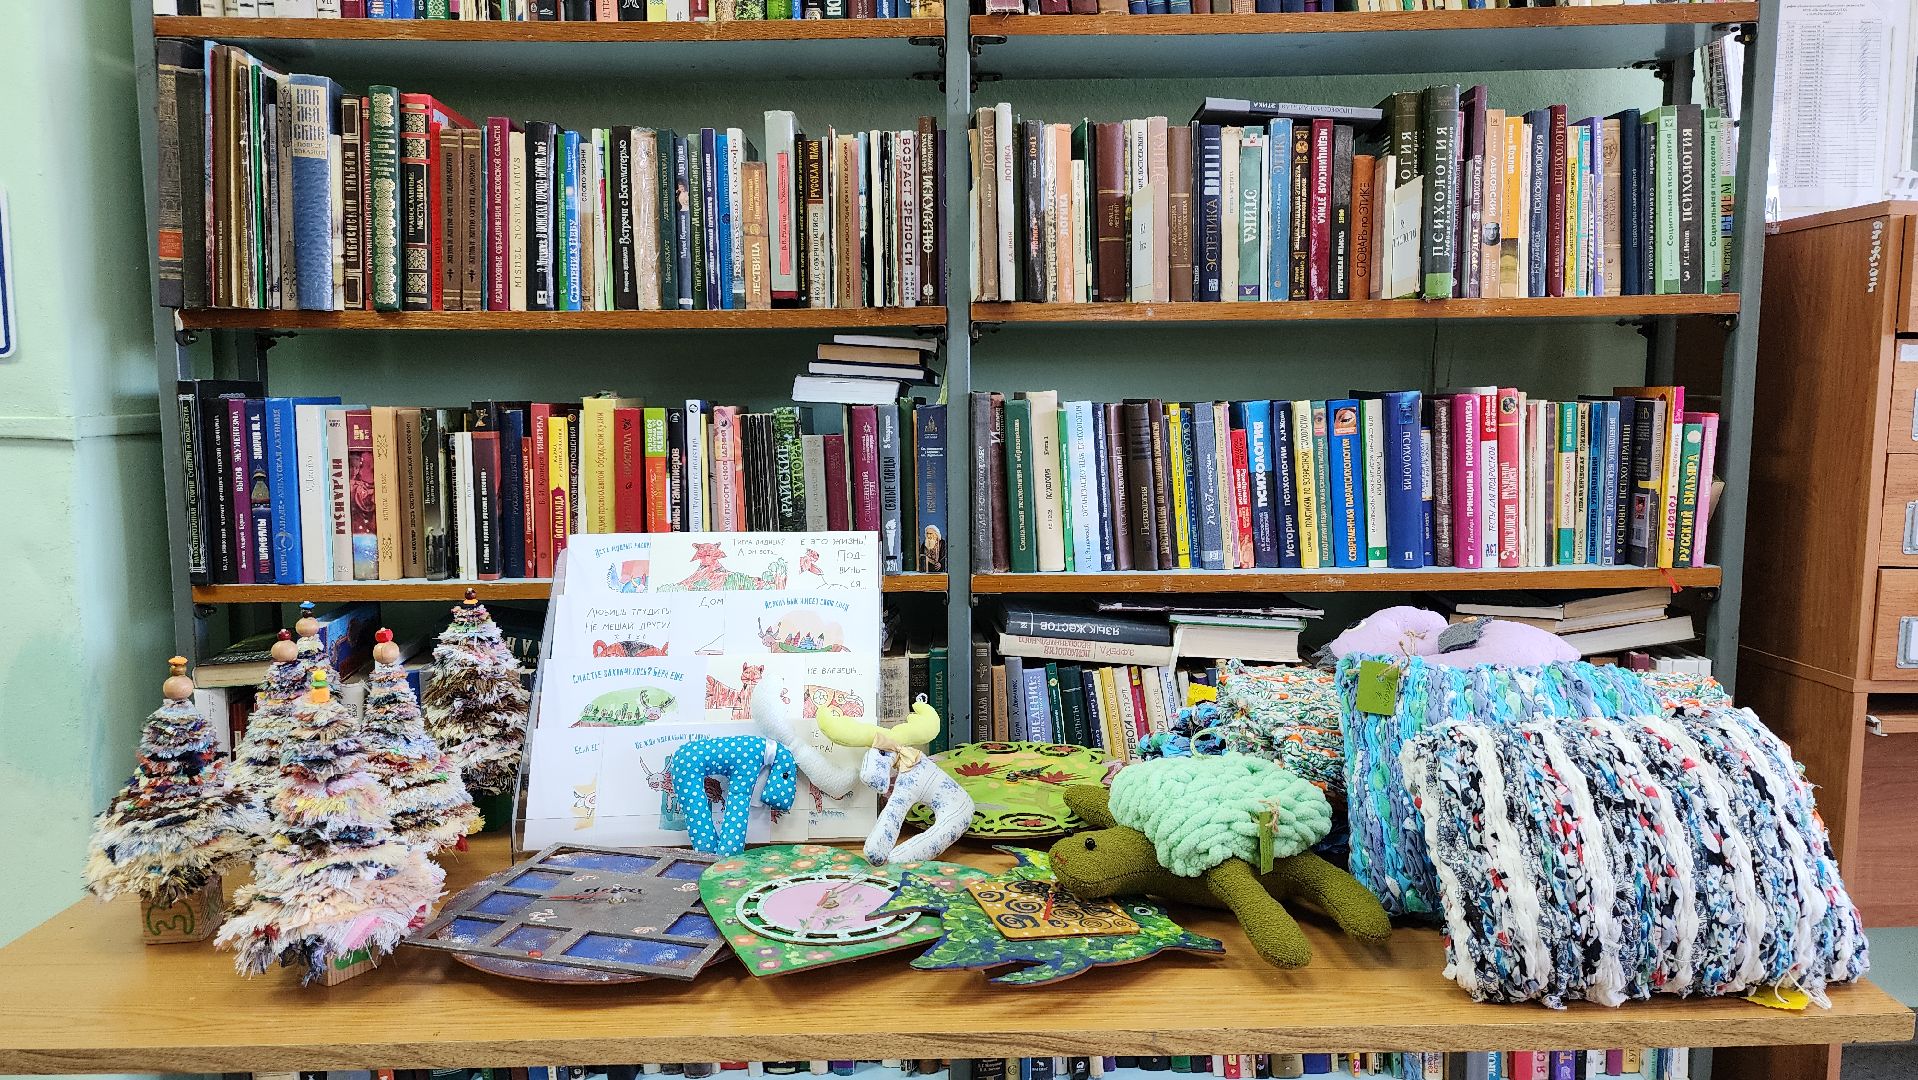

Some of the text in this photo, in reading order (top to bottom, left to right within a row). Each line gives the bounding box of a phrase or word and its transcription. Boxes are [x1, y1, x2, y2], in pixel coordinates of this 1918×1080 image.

[982, 124, 995, 171] ЛОГИКА
[1003, 145, 1012, 183] ЛОГИКА
[1555, 113, 1566, 185] ПСИХОЛОГИЯ
[1682, 127, 1693, 222] ПСИХОЛОГИЯ
[902, 138, 913, 266] ВОЗРАСТ ЗРЕЛОСТИ
[1317, 128, 1329, 225] МЕДИЦИНСКАЯ ЭТИКА
[1433, 126, 1448, 257] ПСИХОЛОГИЯ
[1489, 155, 1499, 217] ЛАБКОВСКИЙ
[620, 208, 632, 245] Встречи
[922, 175, 934, 253] ИСКУССТВО
[1059, 193, 1069, 237] ЛОГИКА
[1205, 198, 1218, 273] ЭСТЕТИКА
[1243, 189, 1258, 244] ЭТИКА
[752, 242, 761, 296] ЛЕСТВИЦА
[1356, 230, 1368, 278] СЛОВАРЬ
[1253, 421, 1268, 508] ПСИХОЛОГИЯ
[1402, 431, 1413, 491] ПСИХОЛОГИЯ
[1465, 400, 1475, 518] ПРИНЦИПЫ ПСИХОАНАЛИЗА
[1617, 423, 1630, 545] ОСНОВЫ ПСИХОТЕРАПИИ
[553, 495, 564, 539] ЙОГАНАНДА
[884, 484, 896, 511] СВЯТЫЕ
[1140, 486, 1150, 536] Психология
[1281, 445, 1295, 558] История психологии
[1343, 438, 1357, 561] СОВРЕМЕННАЯ ПАРАПСИХОЛОГИЯ
[1666, 495, 1677, 541] ГОВОРИ!
[1680, 510, 1692, 562] РУССКИЙ
[1039, 621, 1120, 636] ЯЗЫК ЖЕСТОВ
[1124, 719, 1139, 761] ТРЕВОГА
